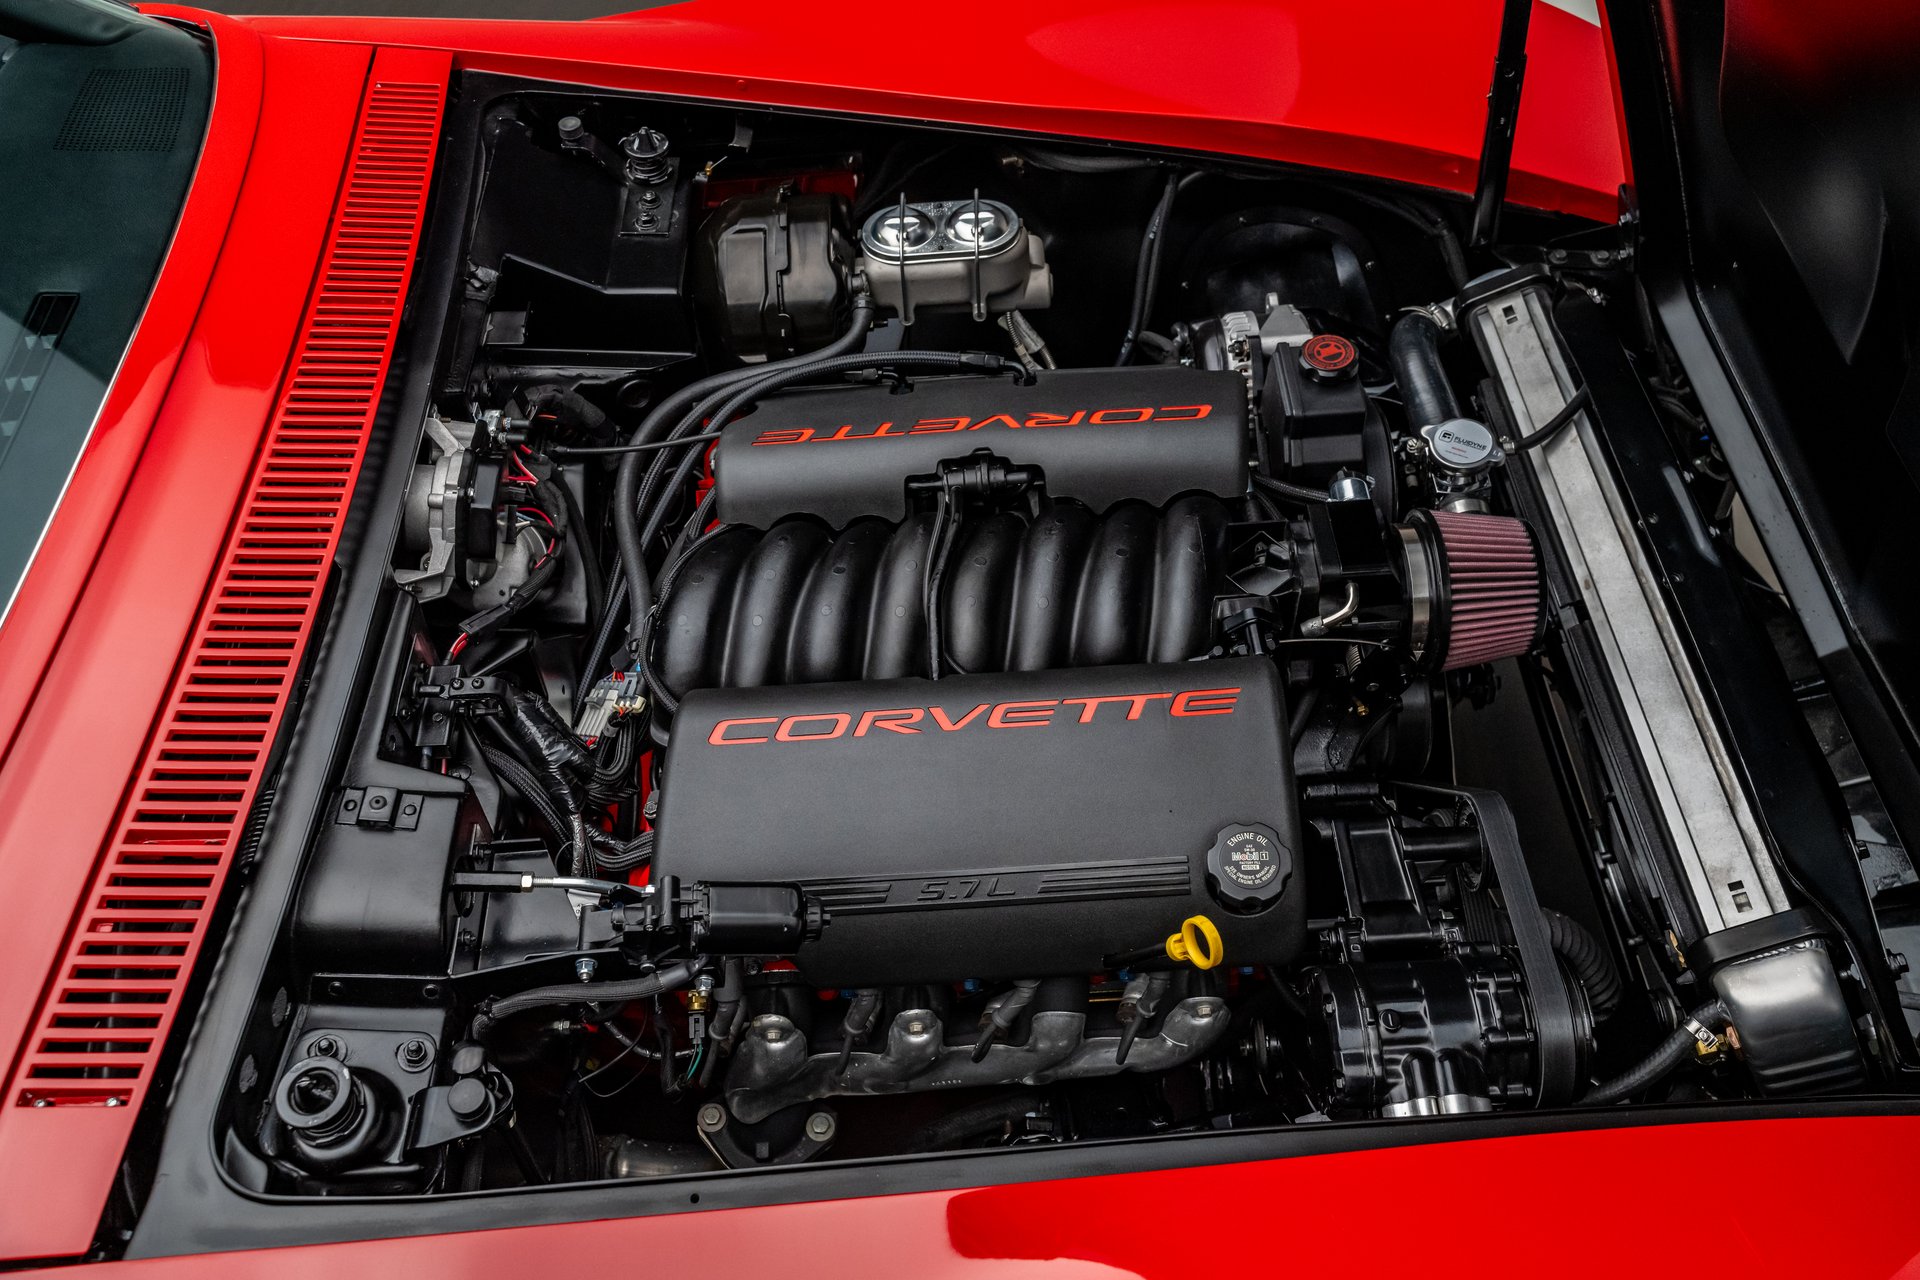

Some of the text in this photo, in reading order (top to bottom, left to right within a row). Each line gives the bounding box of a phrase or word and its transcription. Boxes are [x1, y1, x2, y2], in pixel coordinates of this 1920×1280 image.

[751, 404, 1213, 446] CORVETTE
[1454, 436, 1487, 451] FLUIDYNE
[707, 687, 1242, 746] CORVETTE
[1227, 832, 1268, 847] ENGINE OIL
[1232, 852, 1259, 861] Mobil
[916, 877, 1016, 901] 5.7L
